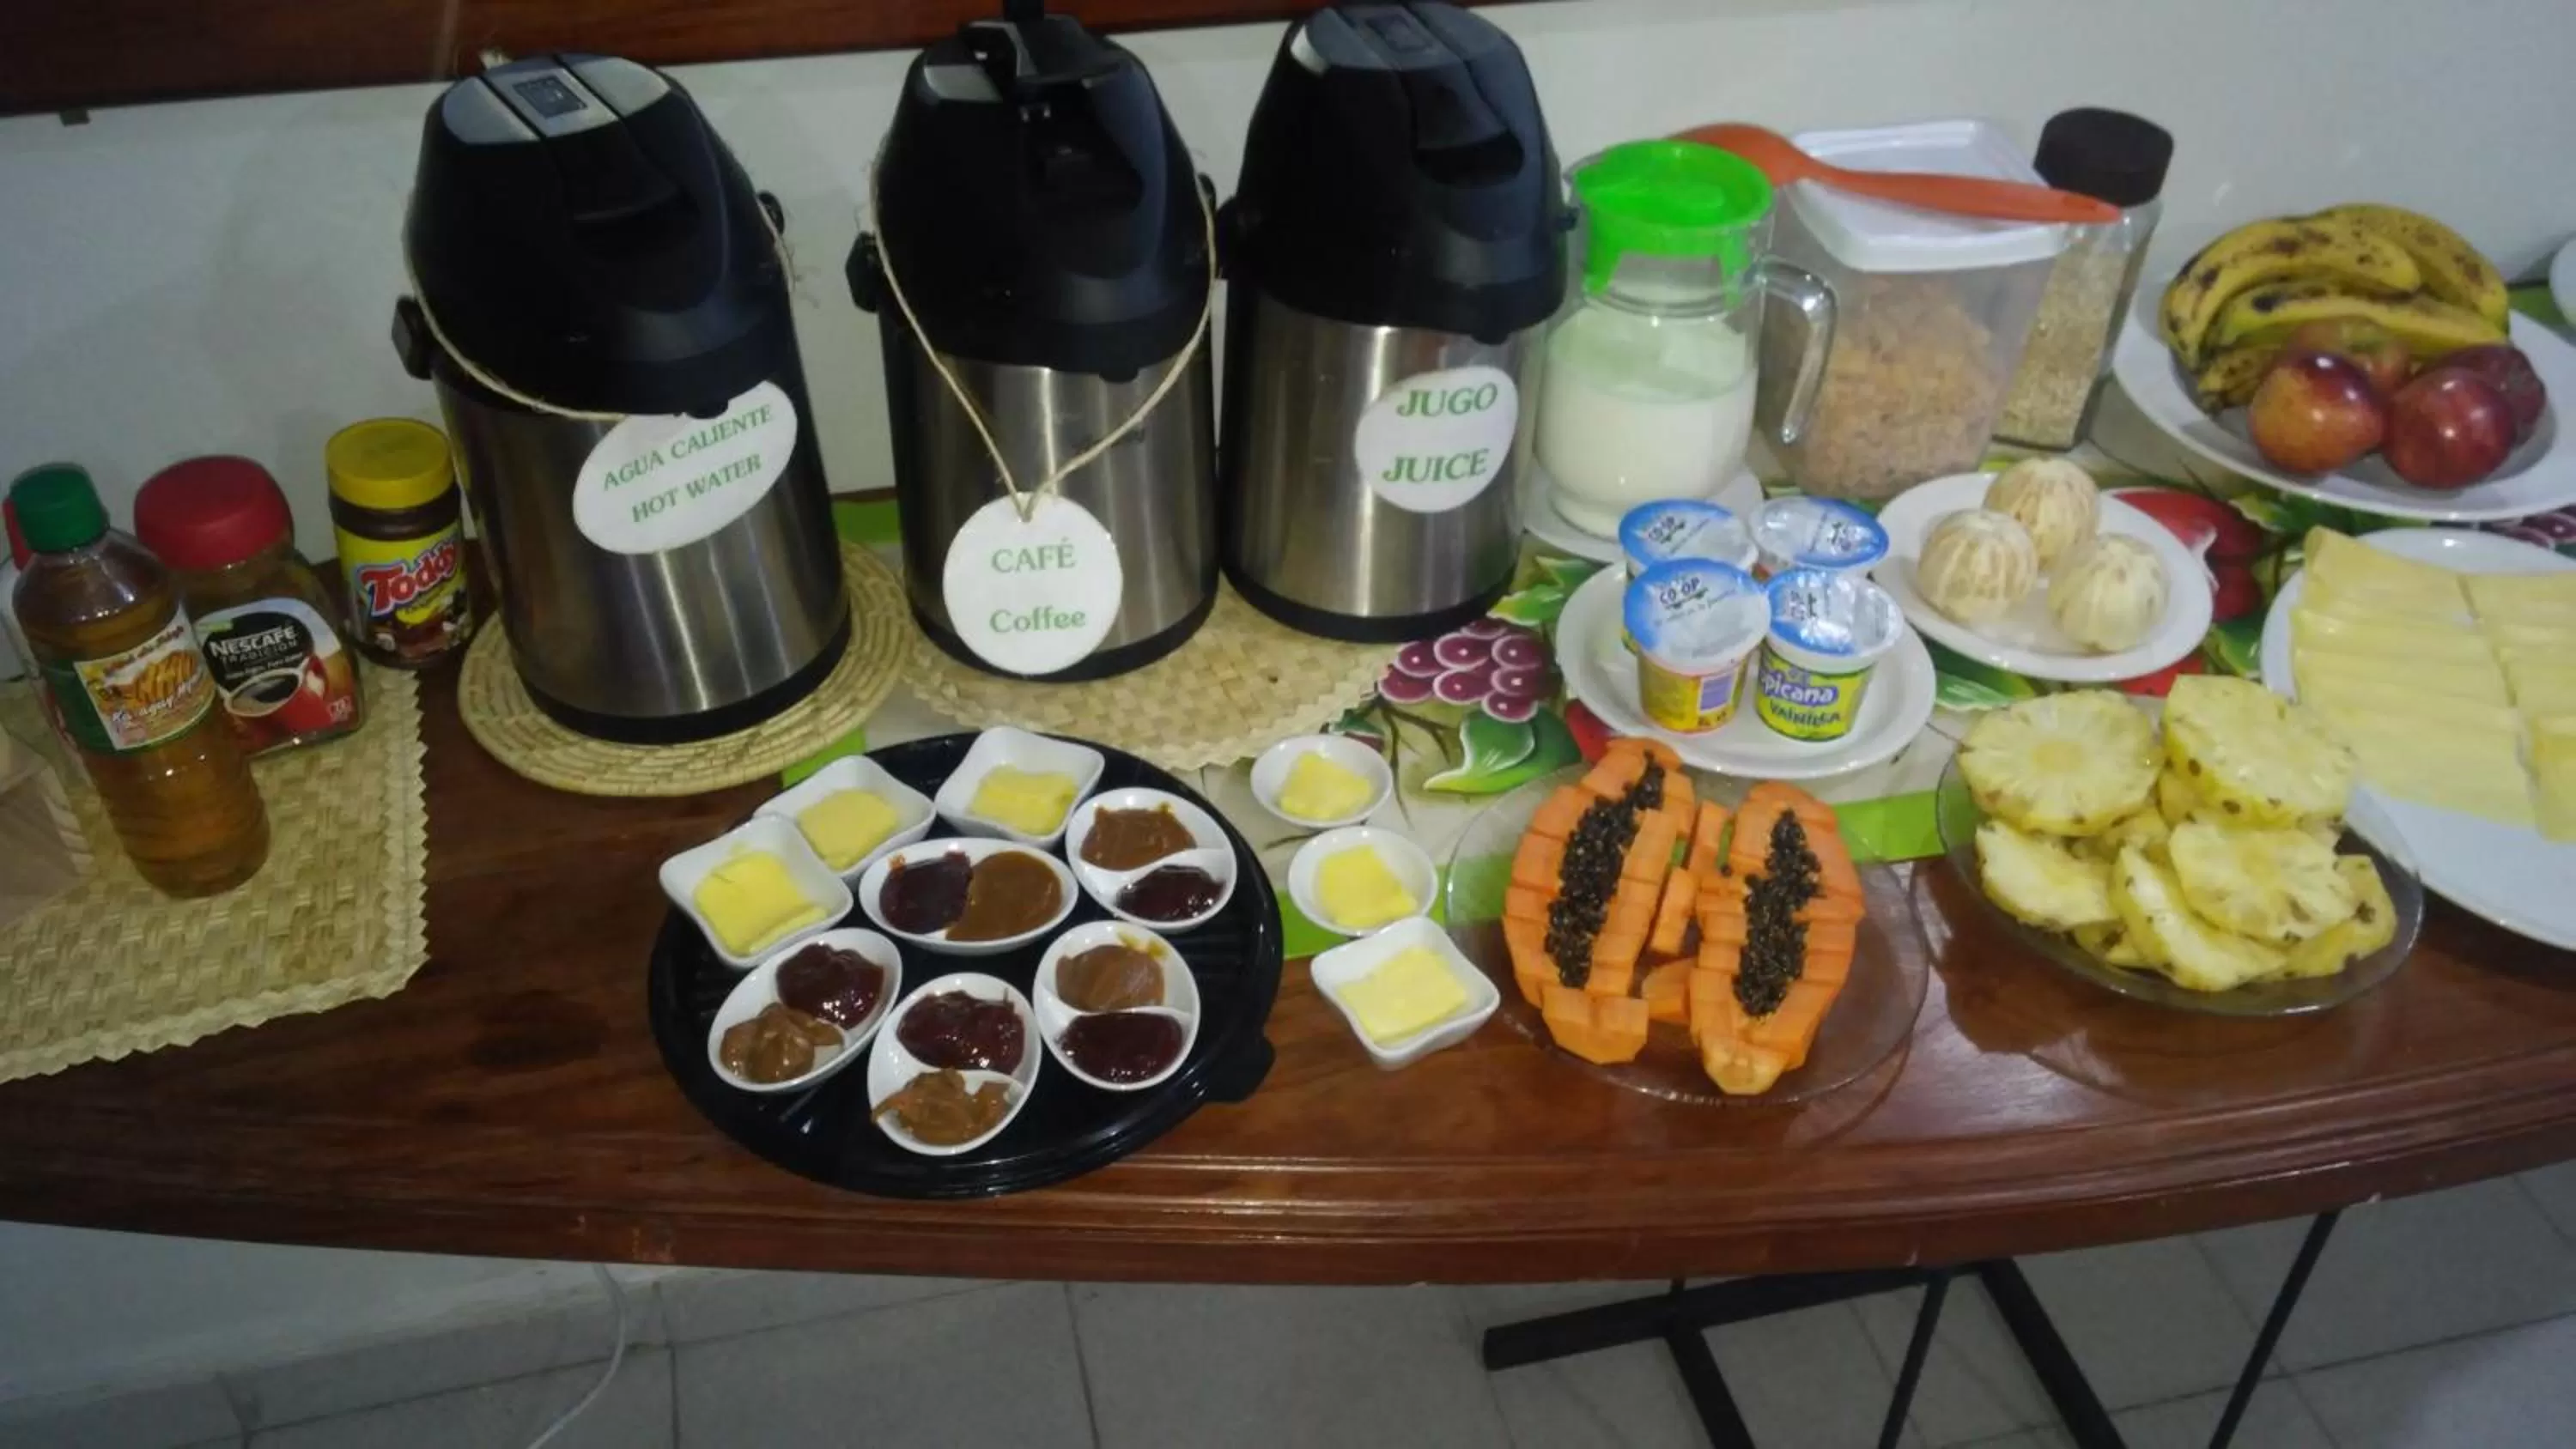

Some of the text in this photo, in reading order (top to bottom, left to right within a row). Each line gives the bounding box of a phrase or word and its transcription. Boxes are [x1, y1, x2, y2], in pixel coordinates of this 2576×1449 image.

[1396, 382, 1498, 418] JUGO
[604, 403, 772, 491] AGUA CALIENTE
[1382, 447, 1491, 484] JUICE
[631, 452, 762, 523] HOT WATER
[991, 536, 1077, 573] CAFÉ
[989, 603, 1087, 634] Coffee
